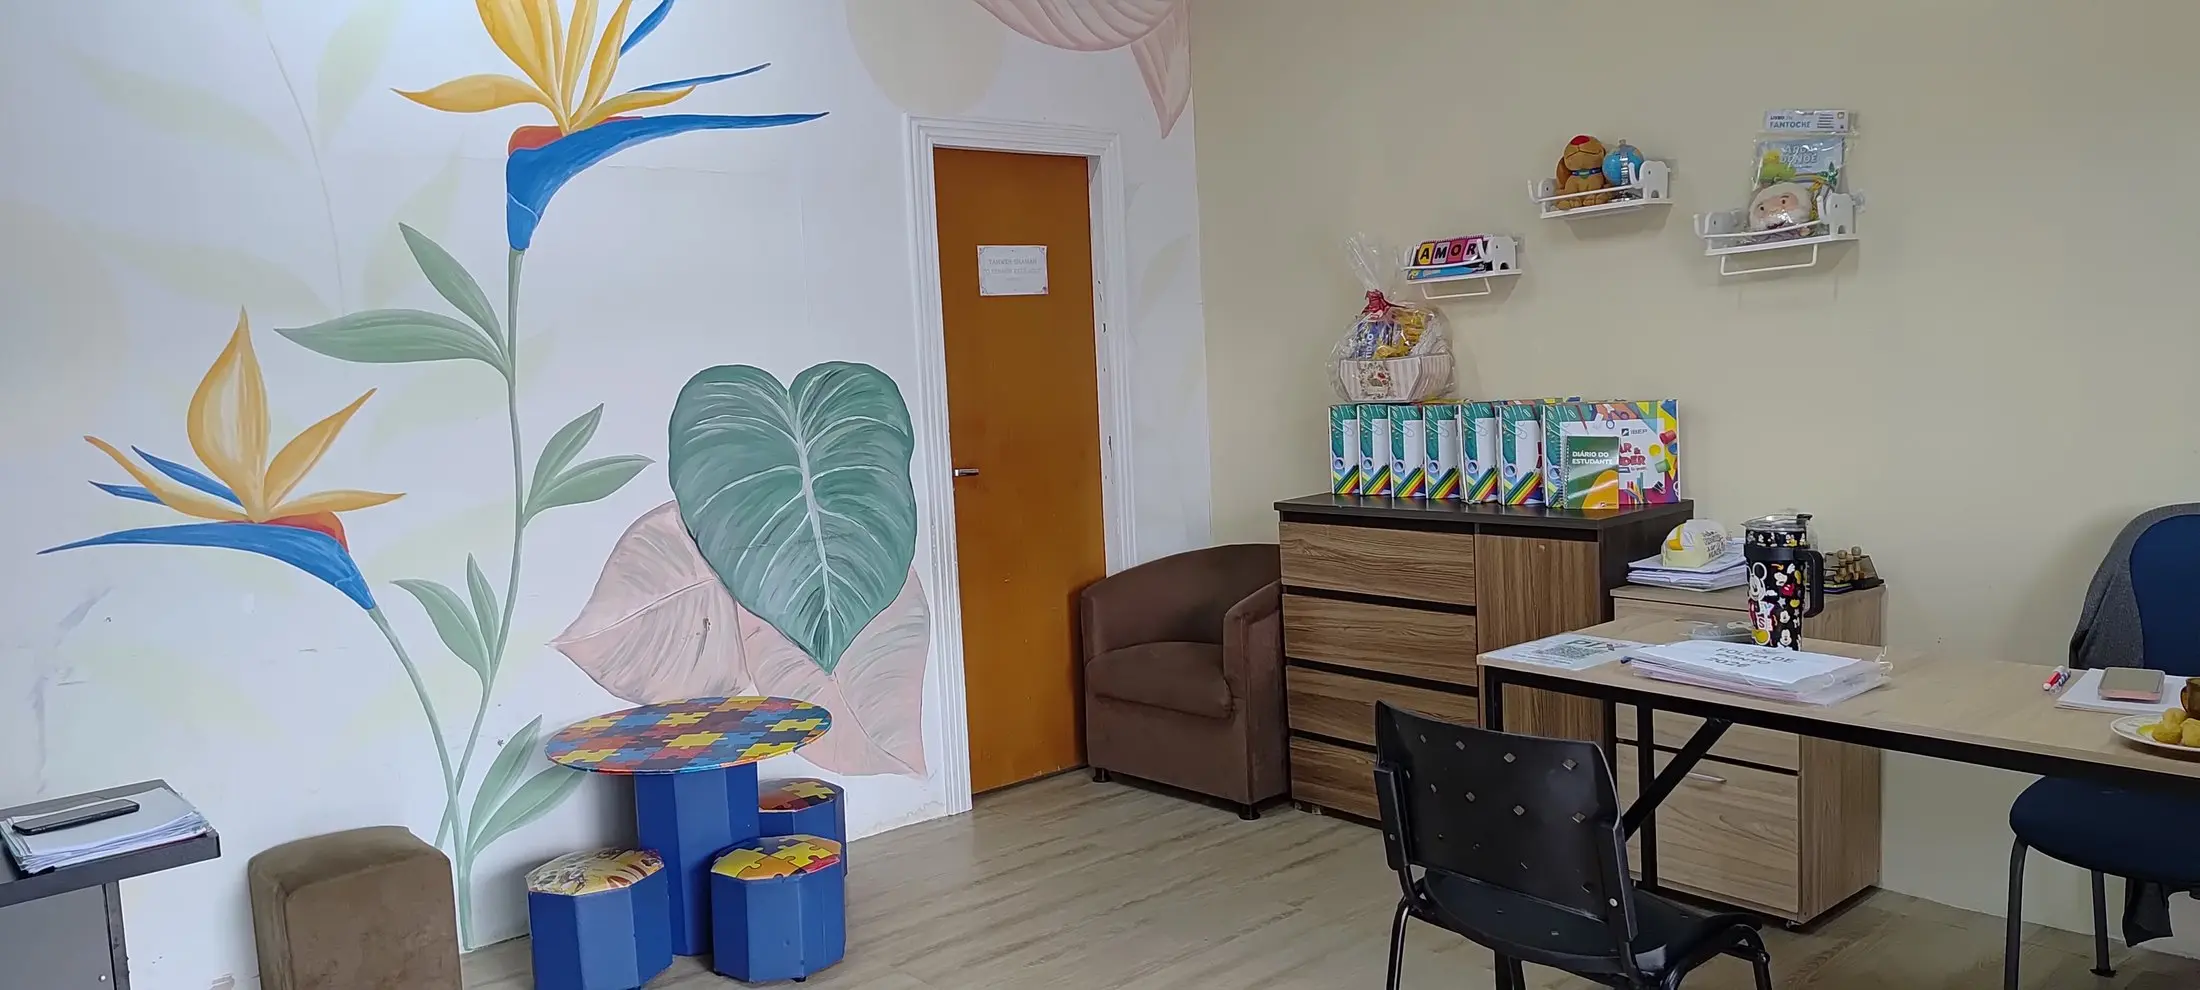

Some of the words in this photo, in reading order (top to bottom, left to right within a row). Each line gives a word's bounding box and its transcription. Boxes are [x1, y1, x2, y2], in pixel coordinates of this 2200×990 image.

[1769, 121, 1811, 129] FANTOCHE
[1420, 243, 1477, 260] AMOR
[1572, 450, 1597, 458] DIÁRIO
